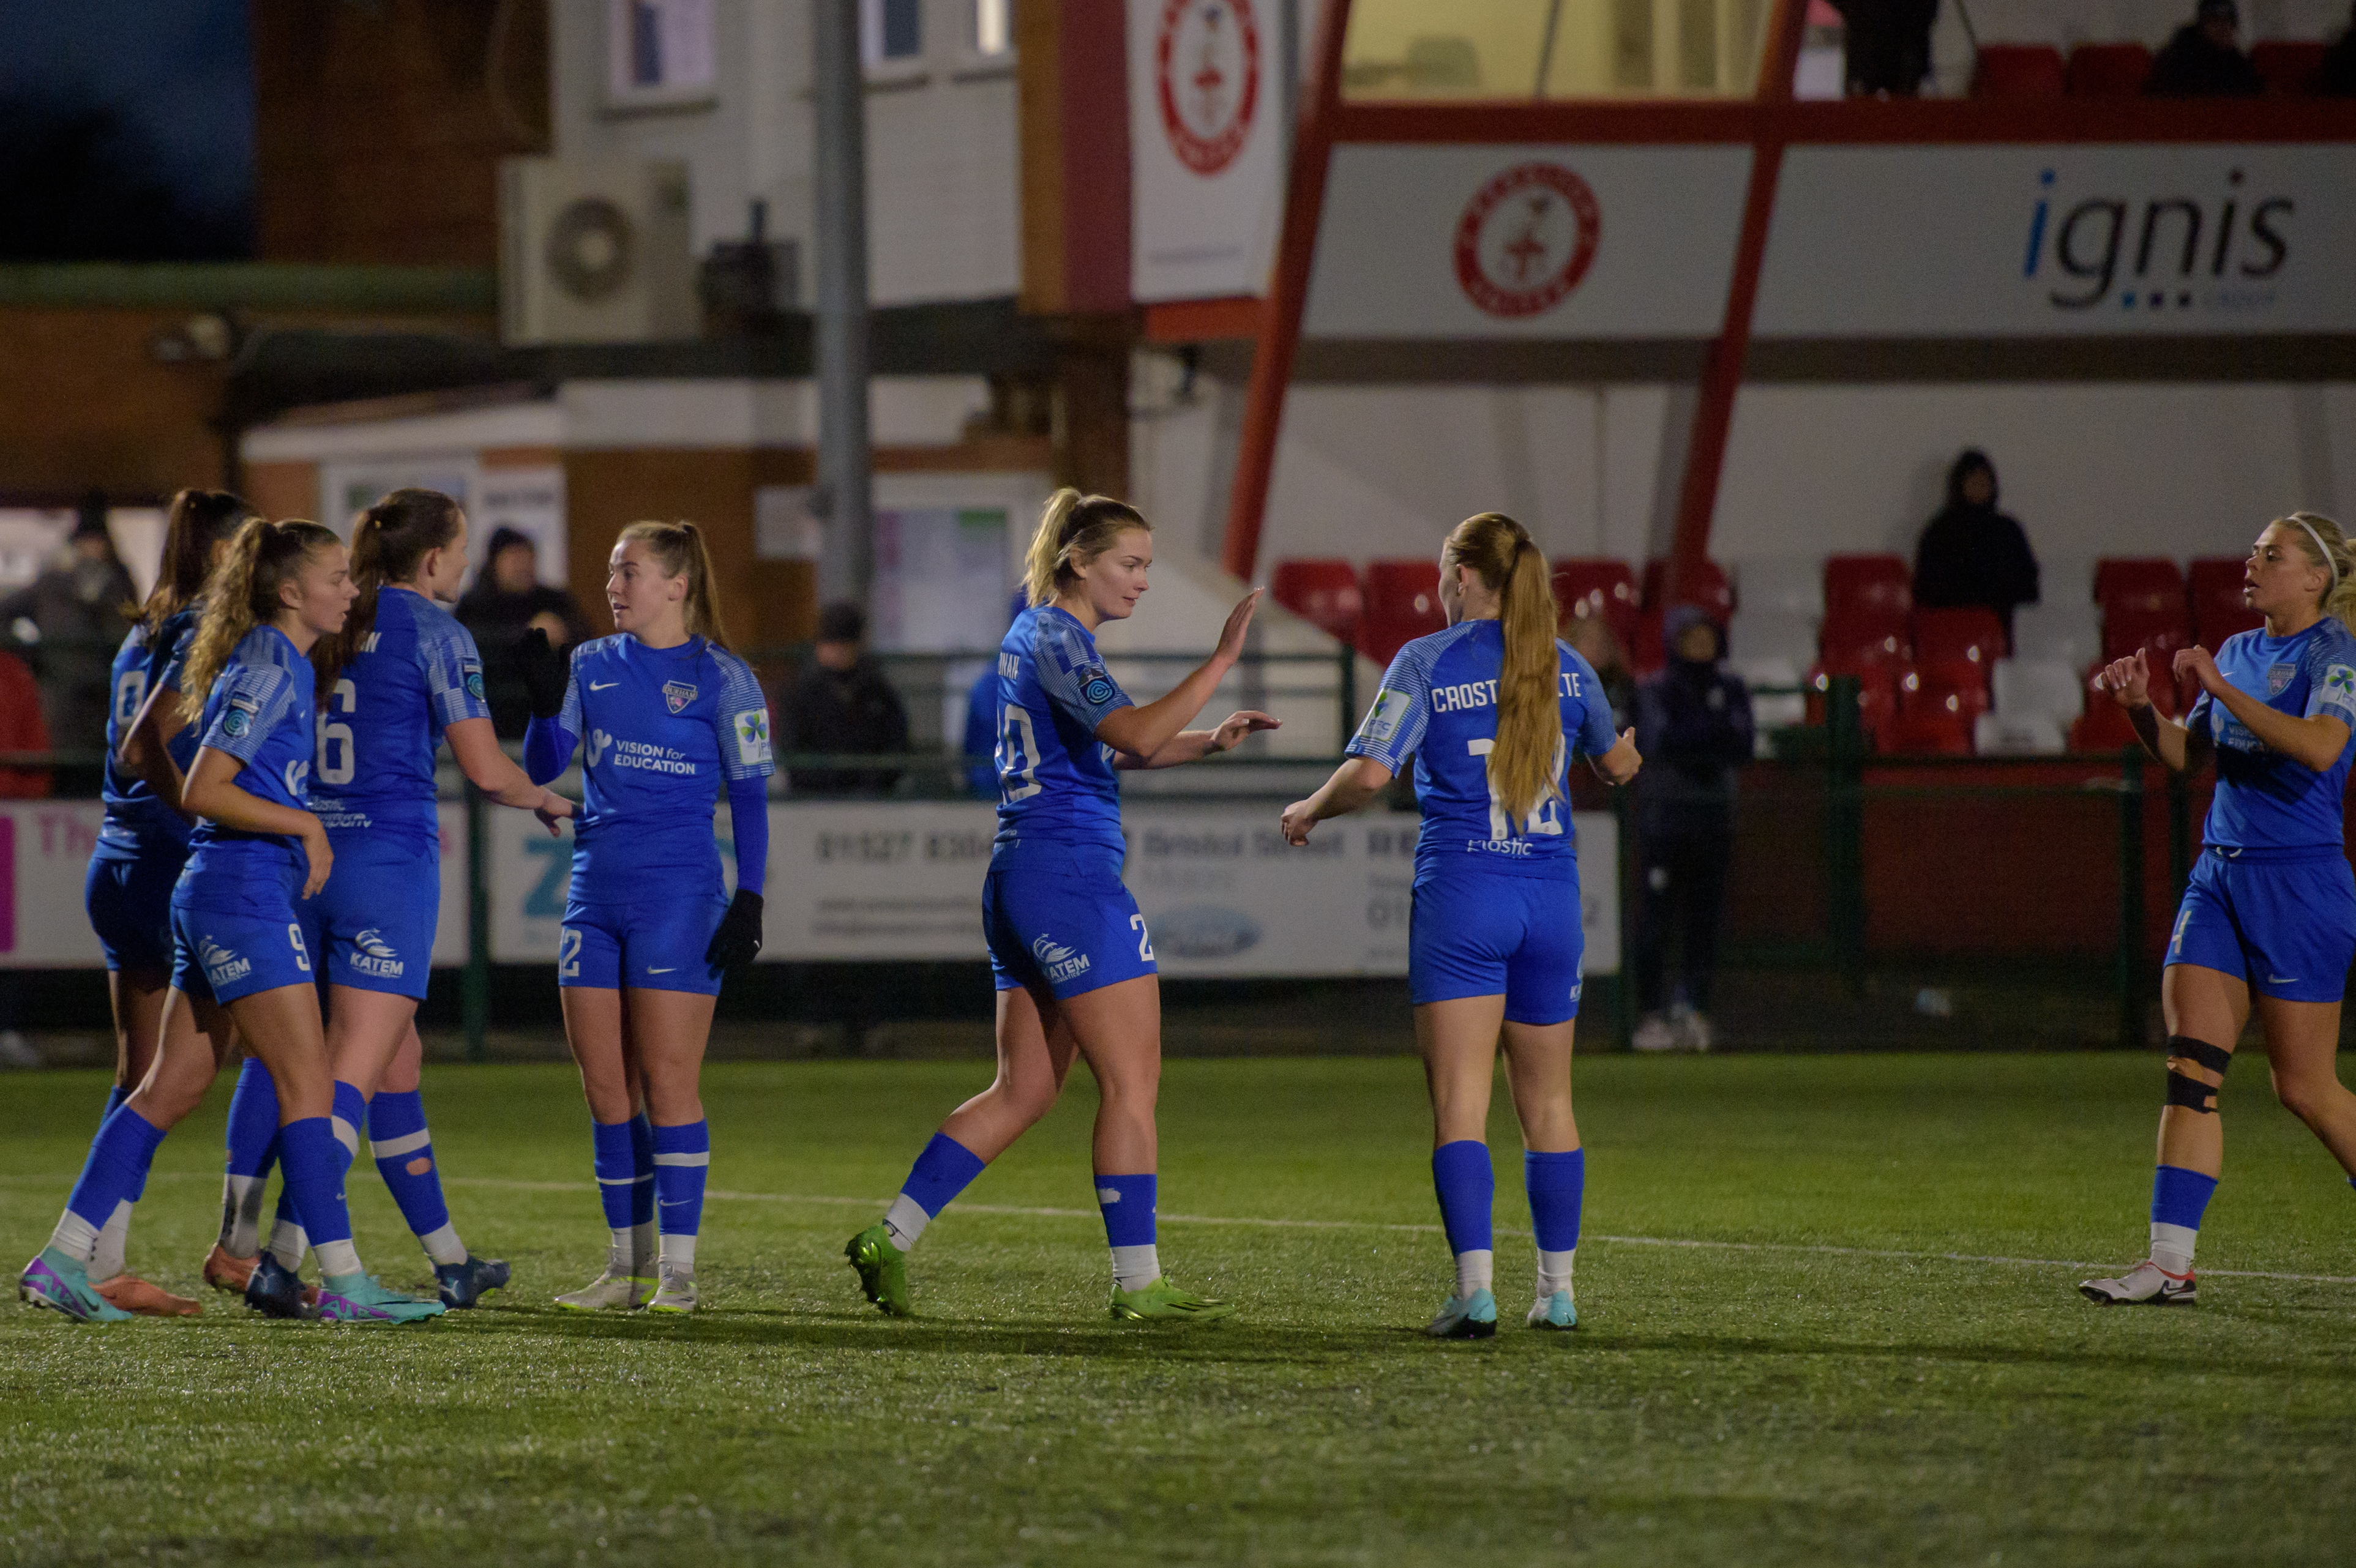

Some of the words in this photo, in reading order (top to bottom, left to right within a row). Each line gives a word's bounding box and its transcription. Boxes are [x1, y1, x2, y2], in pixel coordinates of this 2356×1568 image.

[2024, 168, 2295, 310] ignis
[1431, 672, 1581, 713] CROSTTE
[316, 679, 356, 785] 6
[616, 739, 664, 758] VISION
[666, 748, 686, 760] for
[995, 704, 1044, 804] 0
[613, 753, 696, 775] EDUCATION
[288, 923, 311, 971] 9
[1130, 913, 1156, 962] 2
[209, 957, 252, 982] ATEM
[350, 952, 404, 976] KATEM
